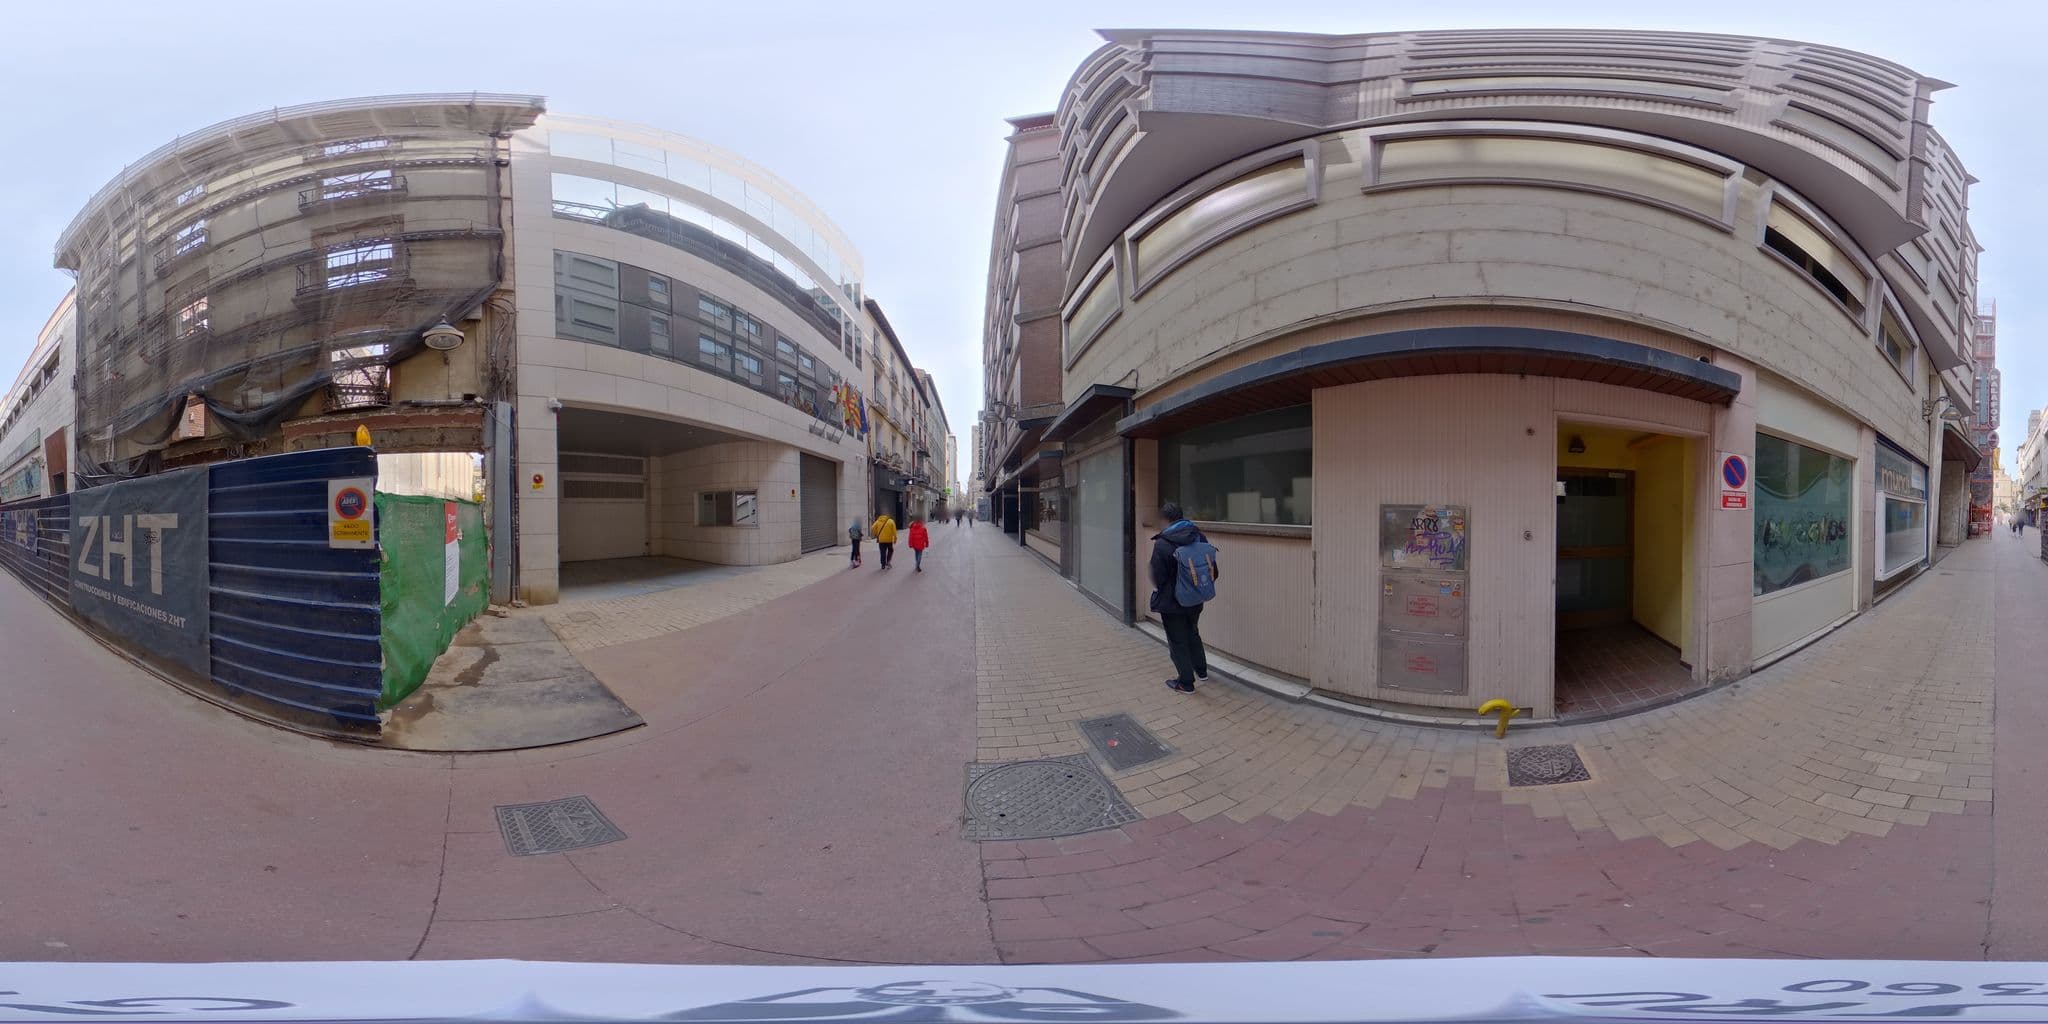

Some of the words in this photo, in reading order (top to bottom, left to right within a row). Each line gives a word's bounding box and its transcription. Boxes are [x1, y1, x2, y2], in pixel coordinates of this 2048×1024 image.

[78, 513, 178, 595] ZHT
[117, 596, 168, 622] EDIFICACIONES
[168, 614, 187, 629] ZHT
